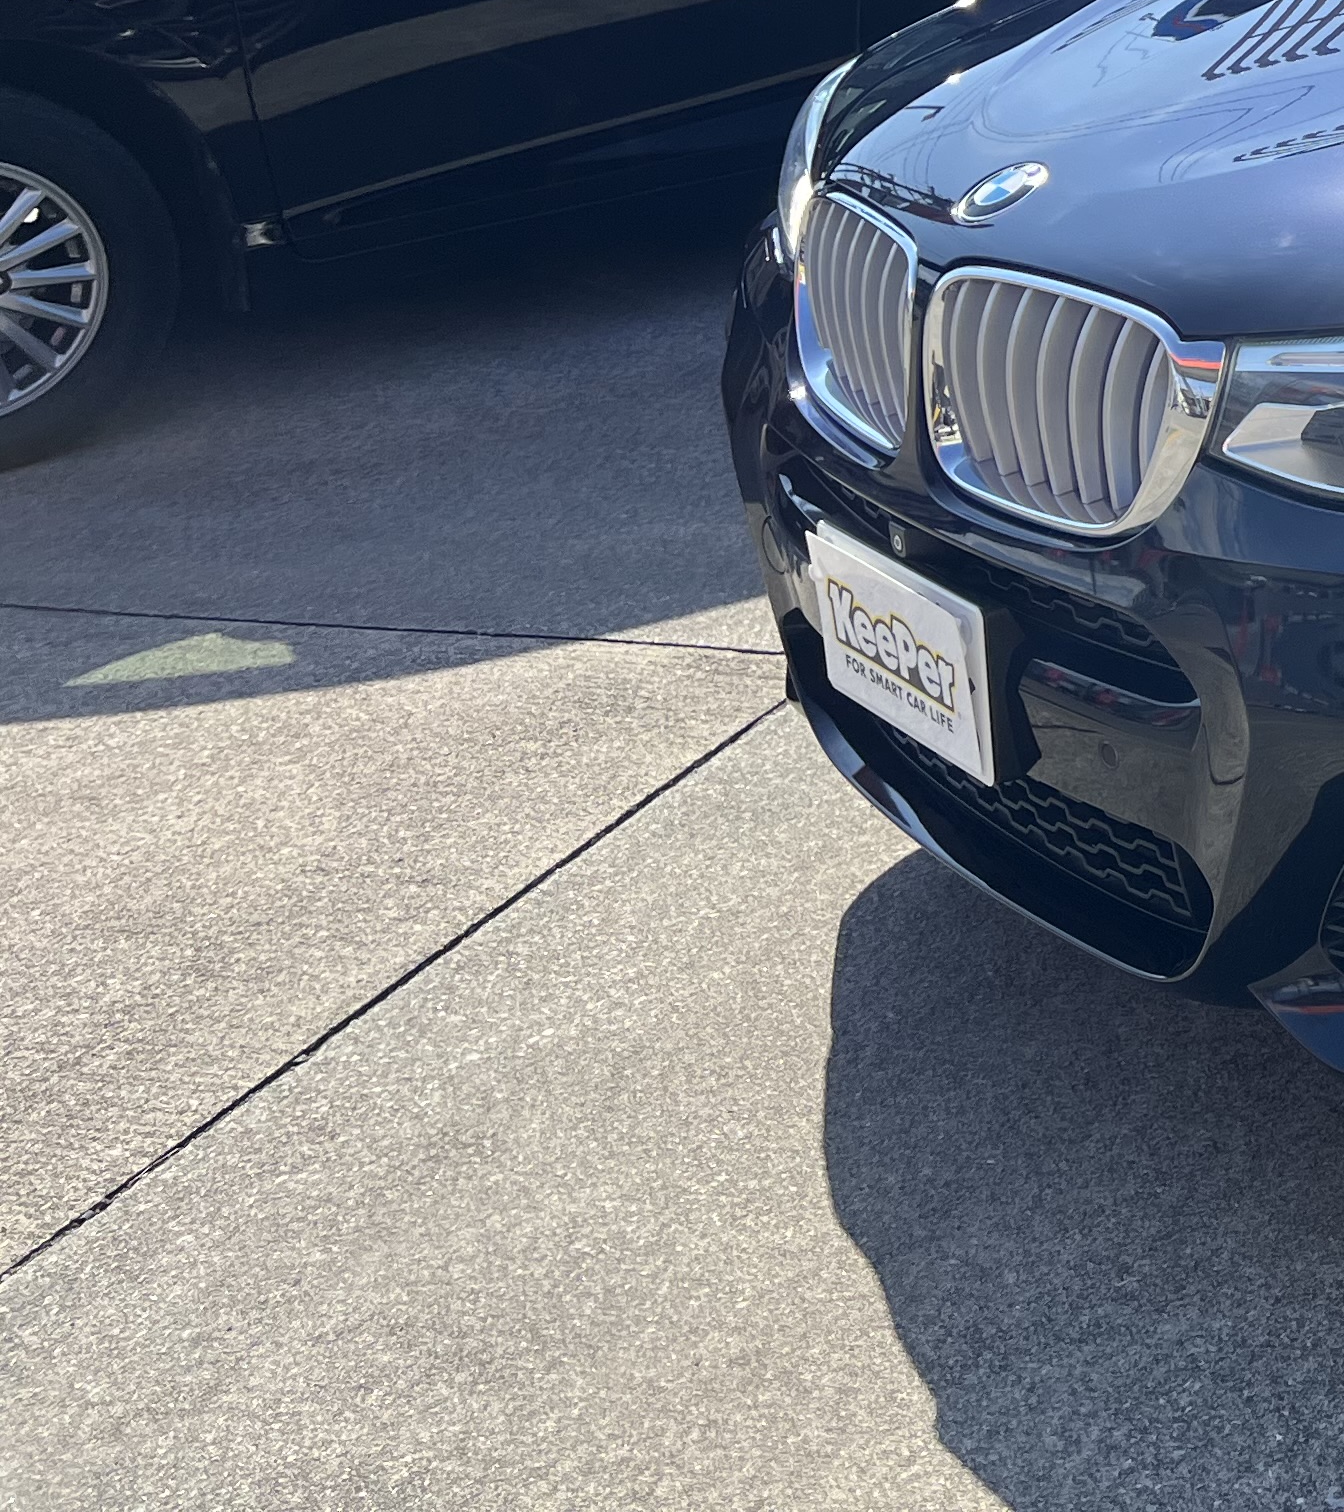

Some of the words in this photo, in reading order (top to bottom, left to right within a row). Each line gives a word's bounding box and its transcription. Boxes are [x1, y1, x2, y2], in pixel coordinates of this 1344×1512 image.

[845, 654, 867, 679] FOR
[870, 666, 903, 702] SMART
[906, 692, 928, 718] CAR
[930, 705, 954, 734] LIFE
